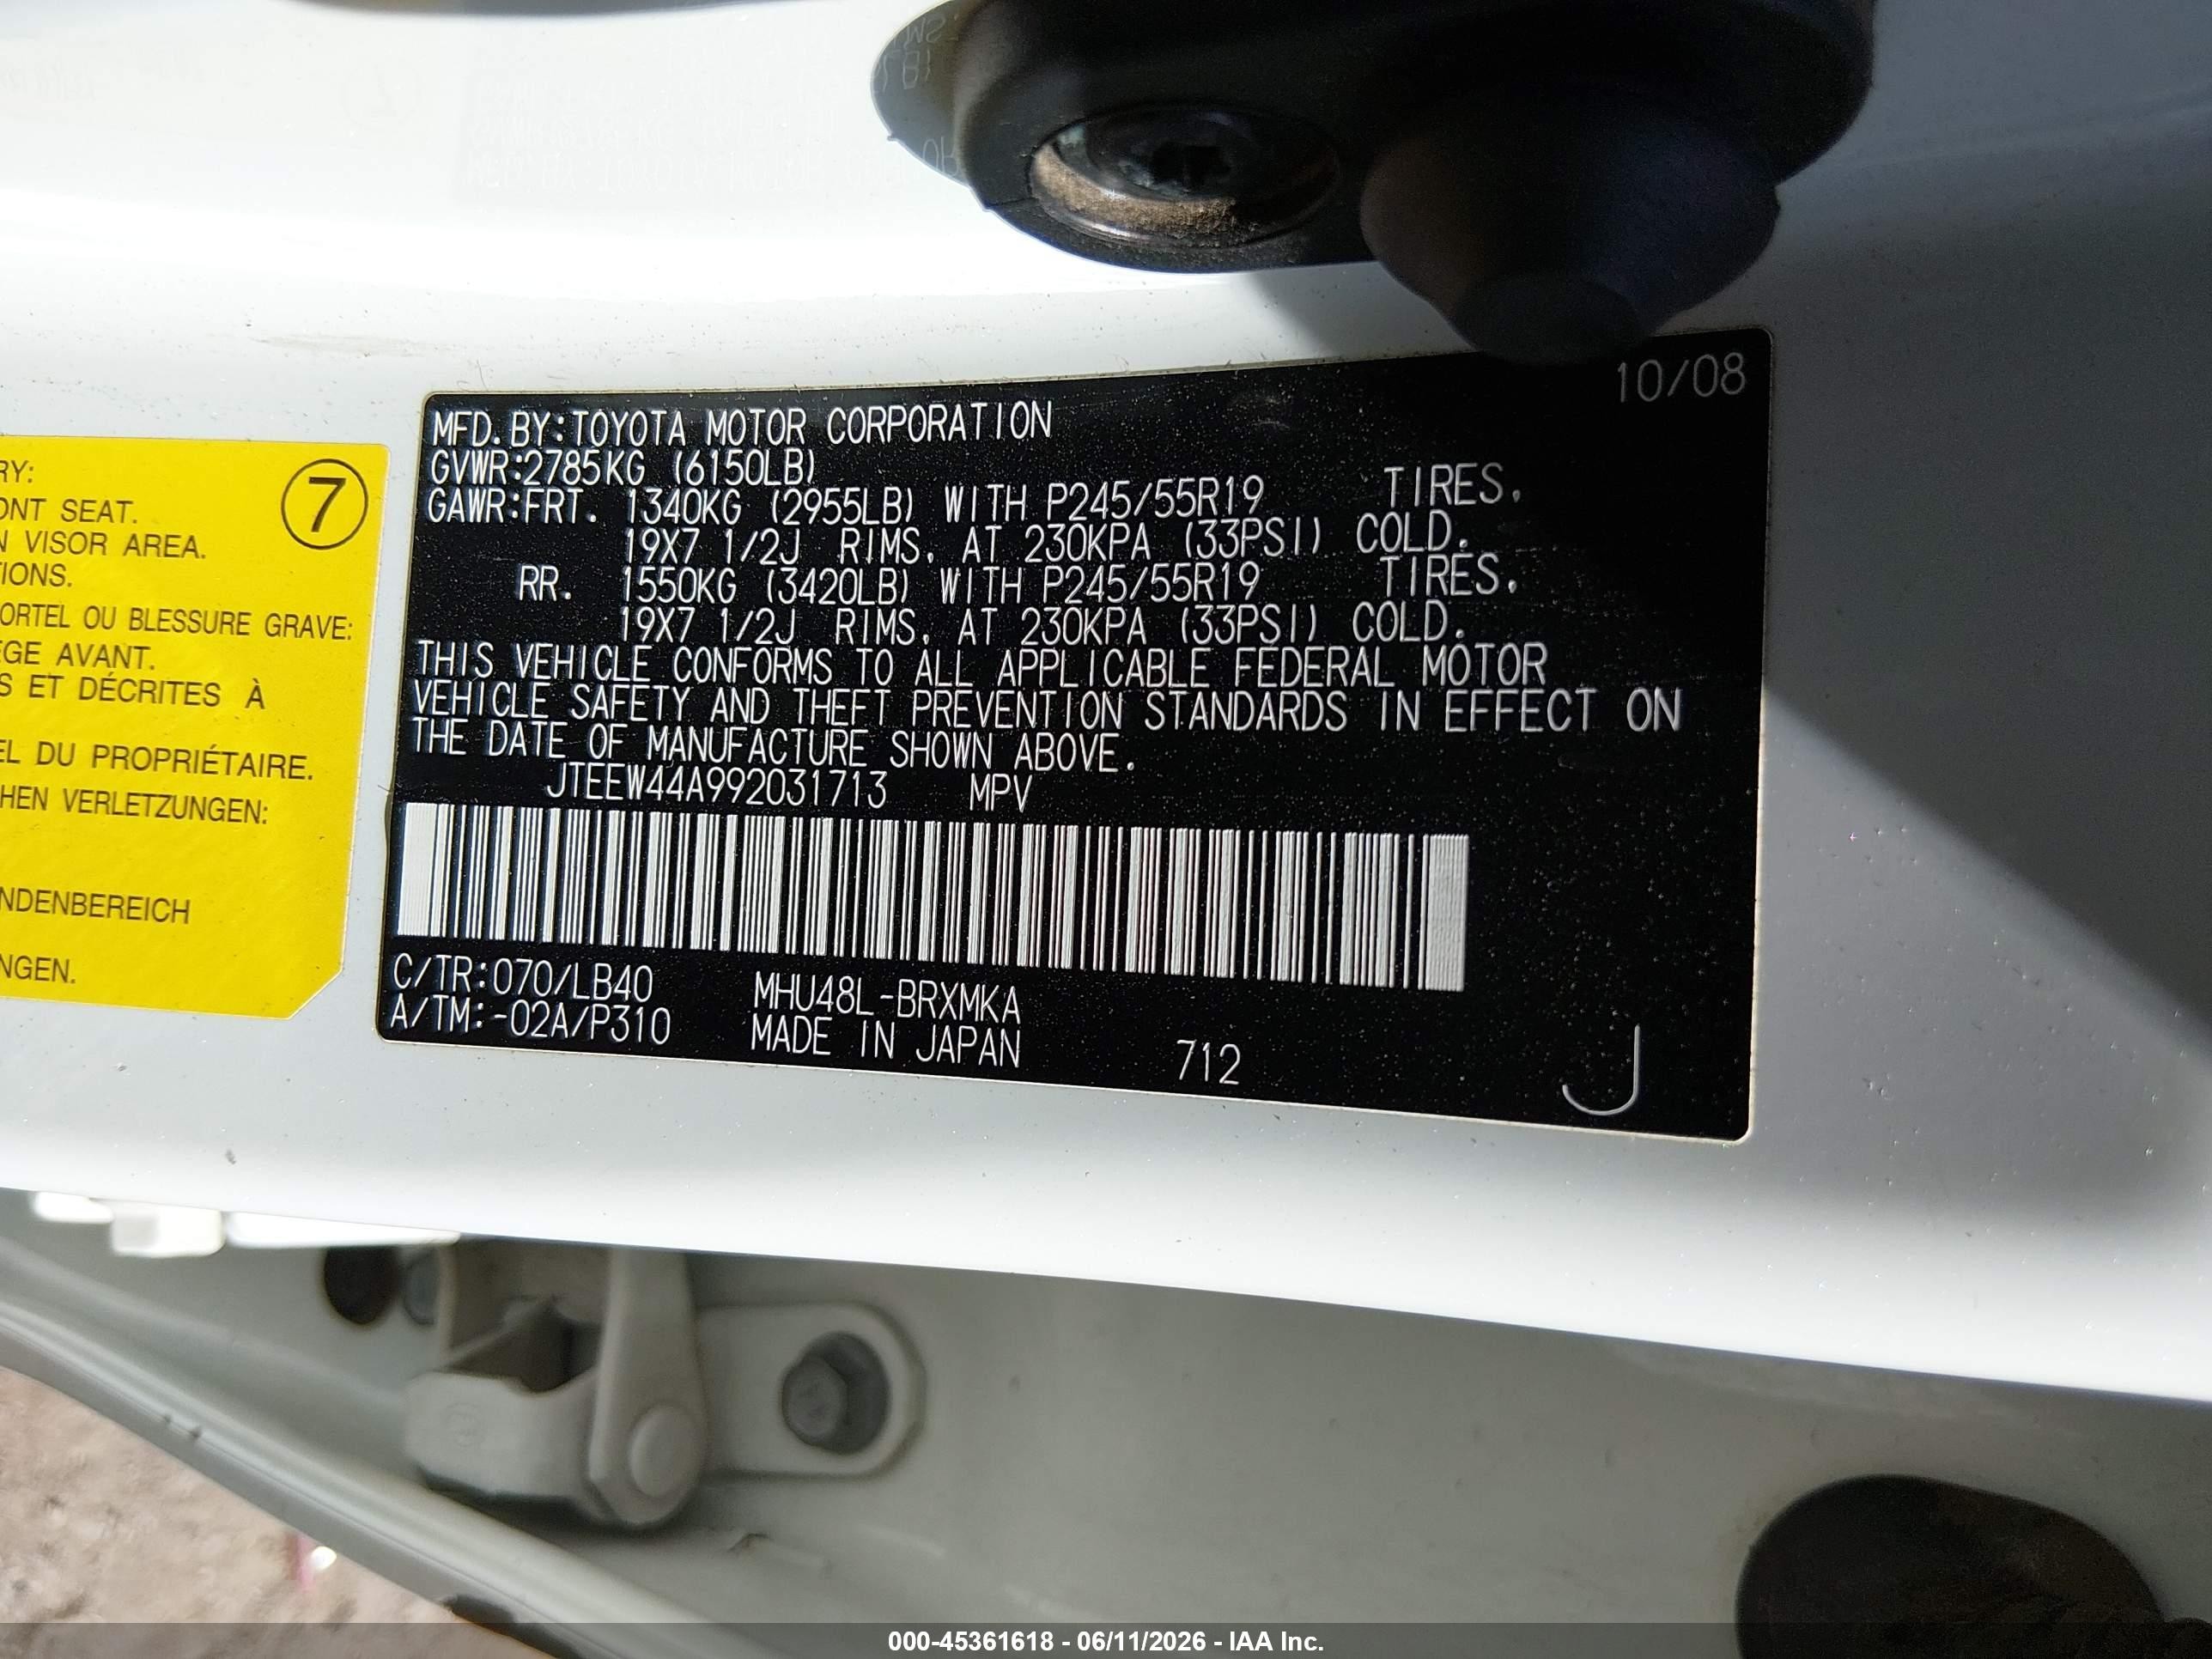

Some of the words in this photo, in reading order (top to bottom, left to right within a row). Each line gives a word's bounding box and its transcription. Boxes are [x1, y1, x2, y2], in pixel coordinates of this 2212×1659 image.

[1618, 352, 1746, 402] 10/08
[707, 407, 805, 446] MOTOR
[828, 400, 1051, 444] CORPORATION
[674, 447, 814, 485] (6150LB)
[61, 499, 137, 523] SEAT.
[309, 477, 346, 532] 7
[629, 488, 741, 525] 1340KG
[773, 487, 912, 525] (2955LB)
[945, 484, 1026, 522] WITH
[1048, 475, 1263, 520] P245/55R19
[1384, 464, 1519, 507] TIRES.
[26, 531, 107, 556] VISOR
[124, 533, 204, 558] AREA.
[628, 528, 700, 563] 19X7
[726, 528, 799, 565] 1/2J
[841, 527, 933, 564] RIMS.
[963, 526, 1002, 563] AT
[1024, 522, 1151, 562] 230KPA
[1186, 517, 1320, 559] (33PSI)
[1357, 509, 1468, 553] COLD.
[0, 562, 71, 586] IONS.
[520, 566, 571, 601] RR.
[625, 566, 736, 604] 1550KG
[768, 568, 908, 605] (3420LB)
[940, 566, 1022, 604] WITH
[1043, 561, 1260, 604] P245/55R19
[1380, 552, 1516, 597] TIRES.
[0, 603, 70, 628] ORTEL
[83, 605, 116, 629] OU
[129, 607, 252, 635] BLESSURE
[265, 613, 352, 640] GRAVE:
[623, 606, 695, 642] 19X7
[721, 608, 795, 644] 1/2J
[836, 608, 929, 645] RIMS.
[958, 608, 998, 645] AT
[1021, 606, 1146, 645] 230KPA
[1182, 604, 1316, 644] (33PSI)
[1352, 599, 1463, 641] COLD.
[0, 641, 41, 665] GE
[56, 643, 154, 670] AVANT.
[418, 640, 493, 678] THIS
[516, 643, 652, 682] VEHICLE
[674, 646, 832, 684] CONFORMS
[856, 648, 893, 685] TO
[915, 649, 973, 687] ALL
[998, 647, 1211, 688] APPLICABLE
[1235, 646, 1395, 687] FEDERAL
[1423, 642, 1547, 686] MOTOR
[29, 674, 64, 698] ET
[79, 672, 221, 707] DÉCRITES
[246, 678, 264, 709] À
[415, 680, 549, 718] VEHICLE
[571, 684, 690, 721] SAFETY
[710, 687, 769, 724] AND
[793, 688, 890, 726] THEFT
[913, 690, 1123, 729] PREVENTION
[1145, 690, 1346, 731] STANDARDS
[1381, 690, 1419, 731] IN
[1445, 688, 1596, 732] EFFECT
[1627, 687, 1680, 732] ON
[36, 741, 75, 767] DU
[93, 744, 313, 780] PROPRIÉTAIRE.
[412, 717, 468, 755] THE
[489, 720, 568, 758] DATE
[590, 723, 628, 759] OF
[647, 725, 868, 767] MANUFACTURE
[890, 731, 992, 769] SHOWN
[1014, 732, 1133, 772] ABOVE.
[64, 788, 269, 824] VERLETZUNGEN:
[547, 762, 887, 808] JTEEW44A992031713
[970, 773, 1032, 812] MPV
[0, 886, 190, 924] NDENBEREICH
[751, 1013, 832, 1054] MADE
[861, 1020, 895, 1059] IN
[916, 1024, 1019, 1067] JAPAN
[1177, 1040, 1240, 1085] 712
[1562, 1025, 1639, 1115] J
